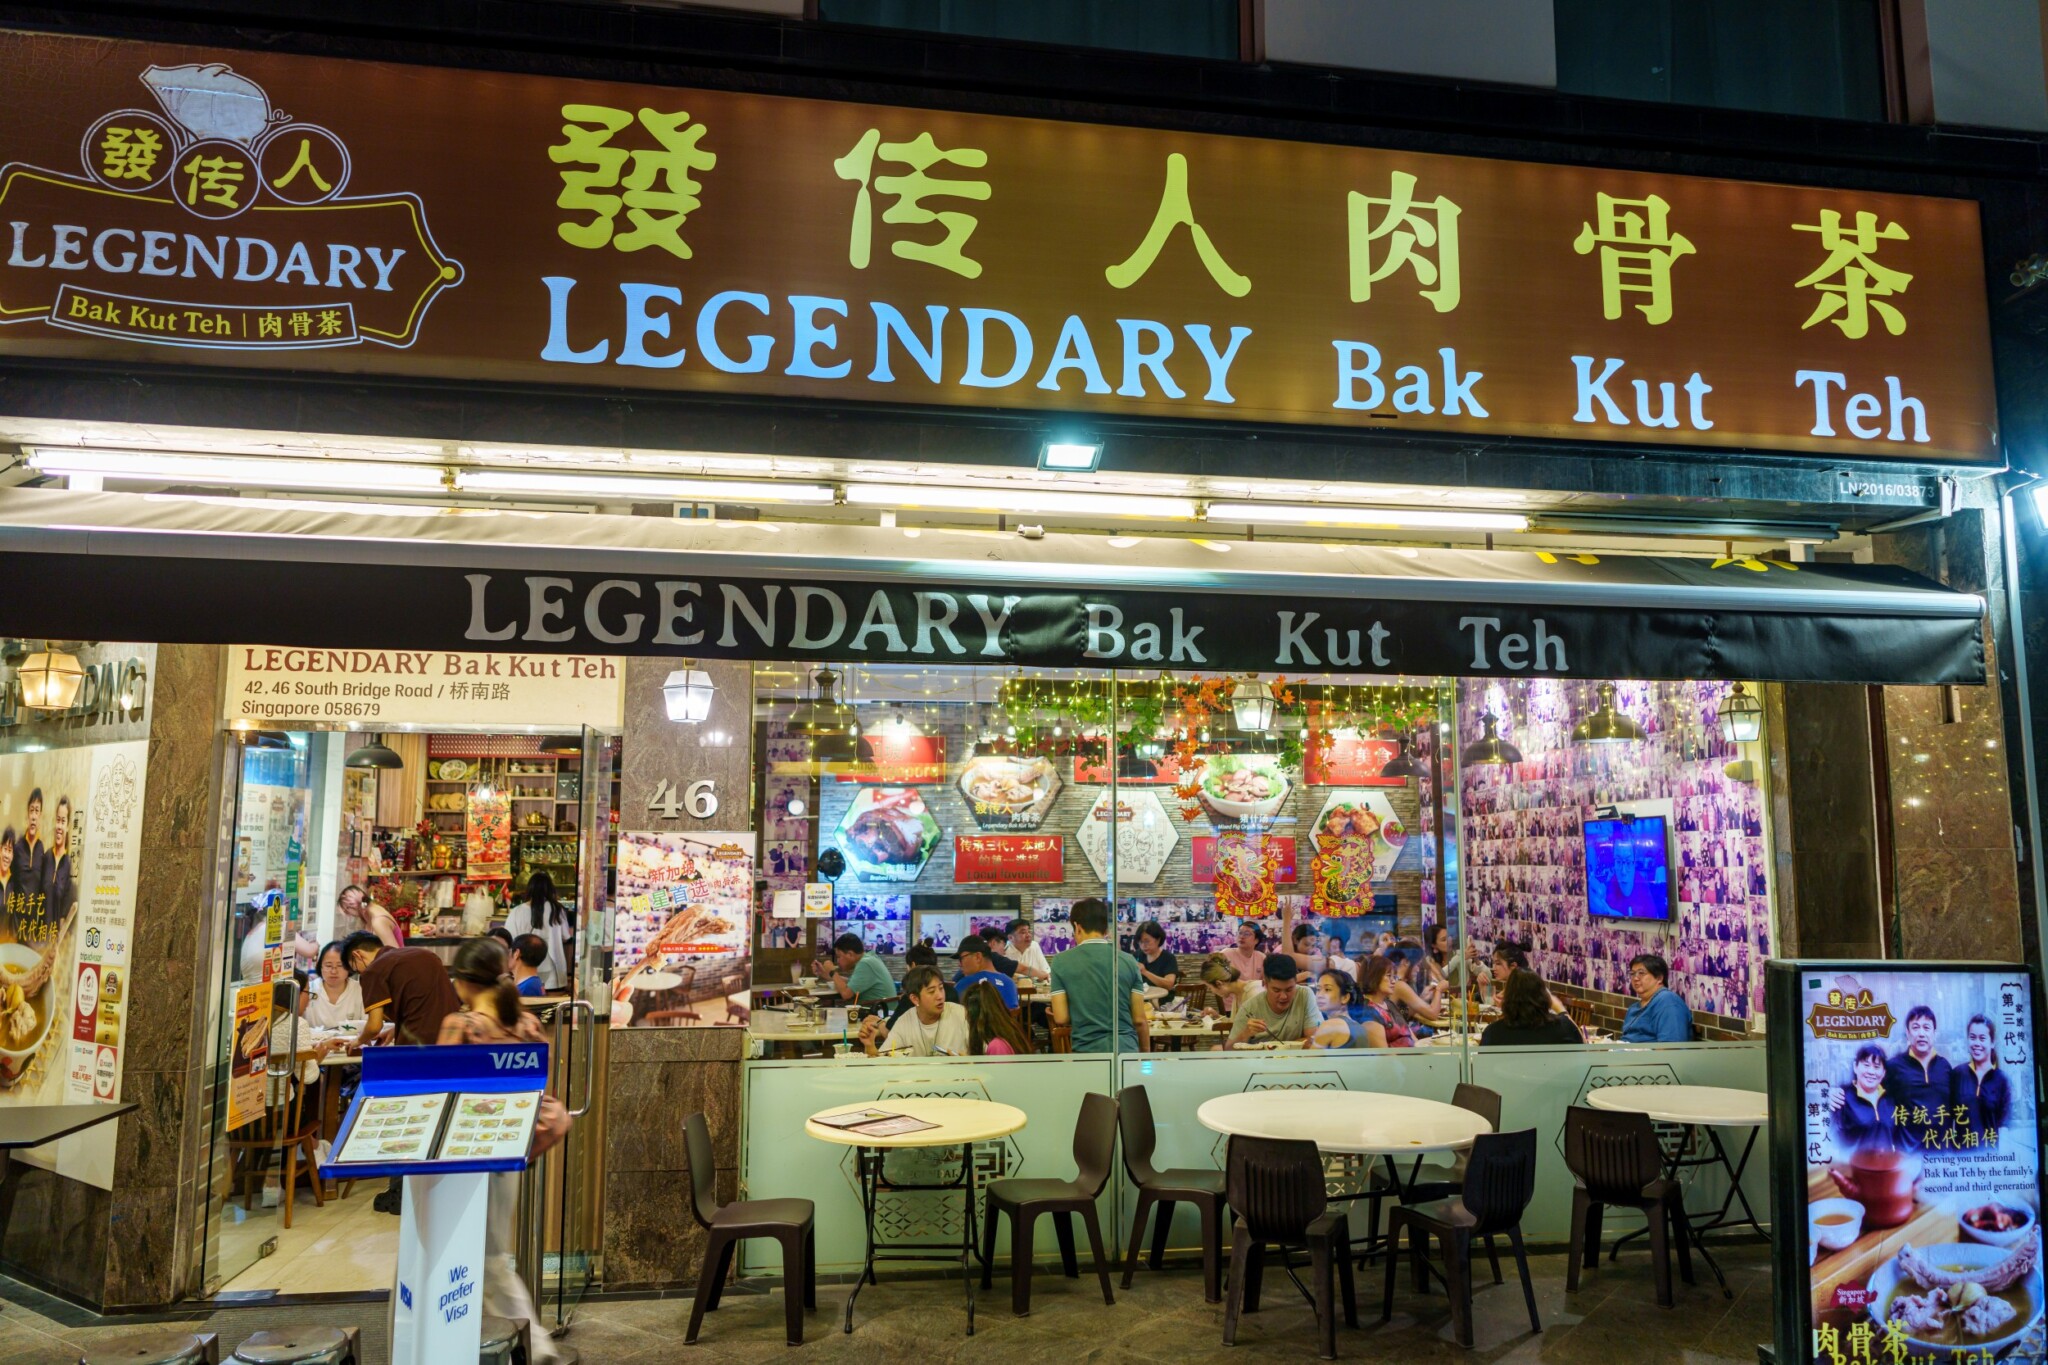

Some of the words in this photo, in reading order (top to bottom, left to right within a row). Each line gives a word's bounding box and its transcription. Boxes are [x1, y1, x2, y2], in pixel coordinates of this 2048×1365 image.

[8, 220, 406, 291] LEGENDARY
[69, 295, 121, 324] Bak
[128, 305, 177, 332] Kut
[184, 311, 231, 335] Teh
[258, 310, 343, 338] 肉骨茶
[540, 276, 1253, 404] LEGENDARY
[1331, 339, 1490, 419] Bak
[1570, 355, 1714, 431] Kut
[1795, 369, 1931, 444] Teh
[464, 573, 1022, 657] LEGENDARY
[1084, 602, 1208, 663] Bak
[1275, 610, 1391, 667] Kut
[1459, 616, 1570, 671] Teh
[244, 648, 434, 675] LEGENDARY
[443, 653, 502, 676] Bak
[508, 655, 562, 678] Kut
[567, 656, 616, 679] Teh
[295, 681, 338, 696] South
[342, 682, 391, 699] Bridge
[395, 683, 433, 698] Road
[449, 681, 511, 701] 桥南路
[242, 700, 320, 717] Singapore
[324, 702, 381, 716] 058679
[648, 777, 719, 820] 46
[1815, 1015, 1887, 1027] LEGENDARY
[2002, 993, 2016, 1046] 第三代
[488, 1051, 540, 1069] VISA
[1891, 1103, 1971, 1126] 传统手艺
[1807, 1102, 1822, 1157] 第二代
[1921, 1127, 1999, 1149] 代代相传
[1923, 1153, 1956, 1166] Serving
[1956, 1157, 1972, 1168] you
[1973, 1151, 2016, 1162] traditional
[1924, 1168, 1941, 1178] Bak
[1942, 1168, 1958, 1178] Kut
[1960, 1167, 1976, 1177] Teh
[1977, 1167, 1987, 1180] by
[1988, 1166, 2002, 1177] the
[2003, 1166, 2034, 1179] family's
[1924, 1182, 1954, 1193] second
[1955, 1181, 1970, 1192] and
[1971, 1180, 1992, 1191] third
[1993, 1181, 2036, 1194] generation
[450, 1264, 468, 1283] We
[400, 1279, 412, 1310] VISA
[439, 1280, 475, 1311] prefer
[1837, 1289, 1866, 1298] Singapore
[445, 1302, 469, 1323] Visa
[1812, 1318, 1910, 1359] 肉骨茶
